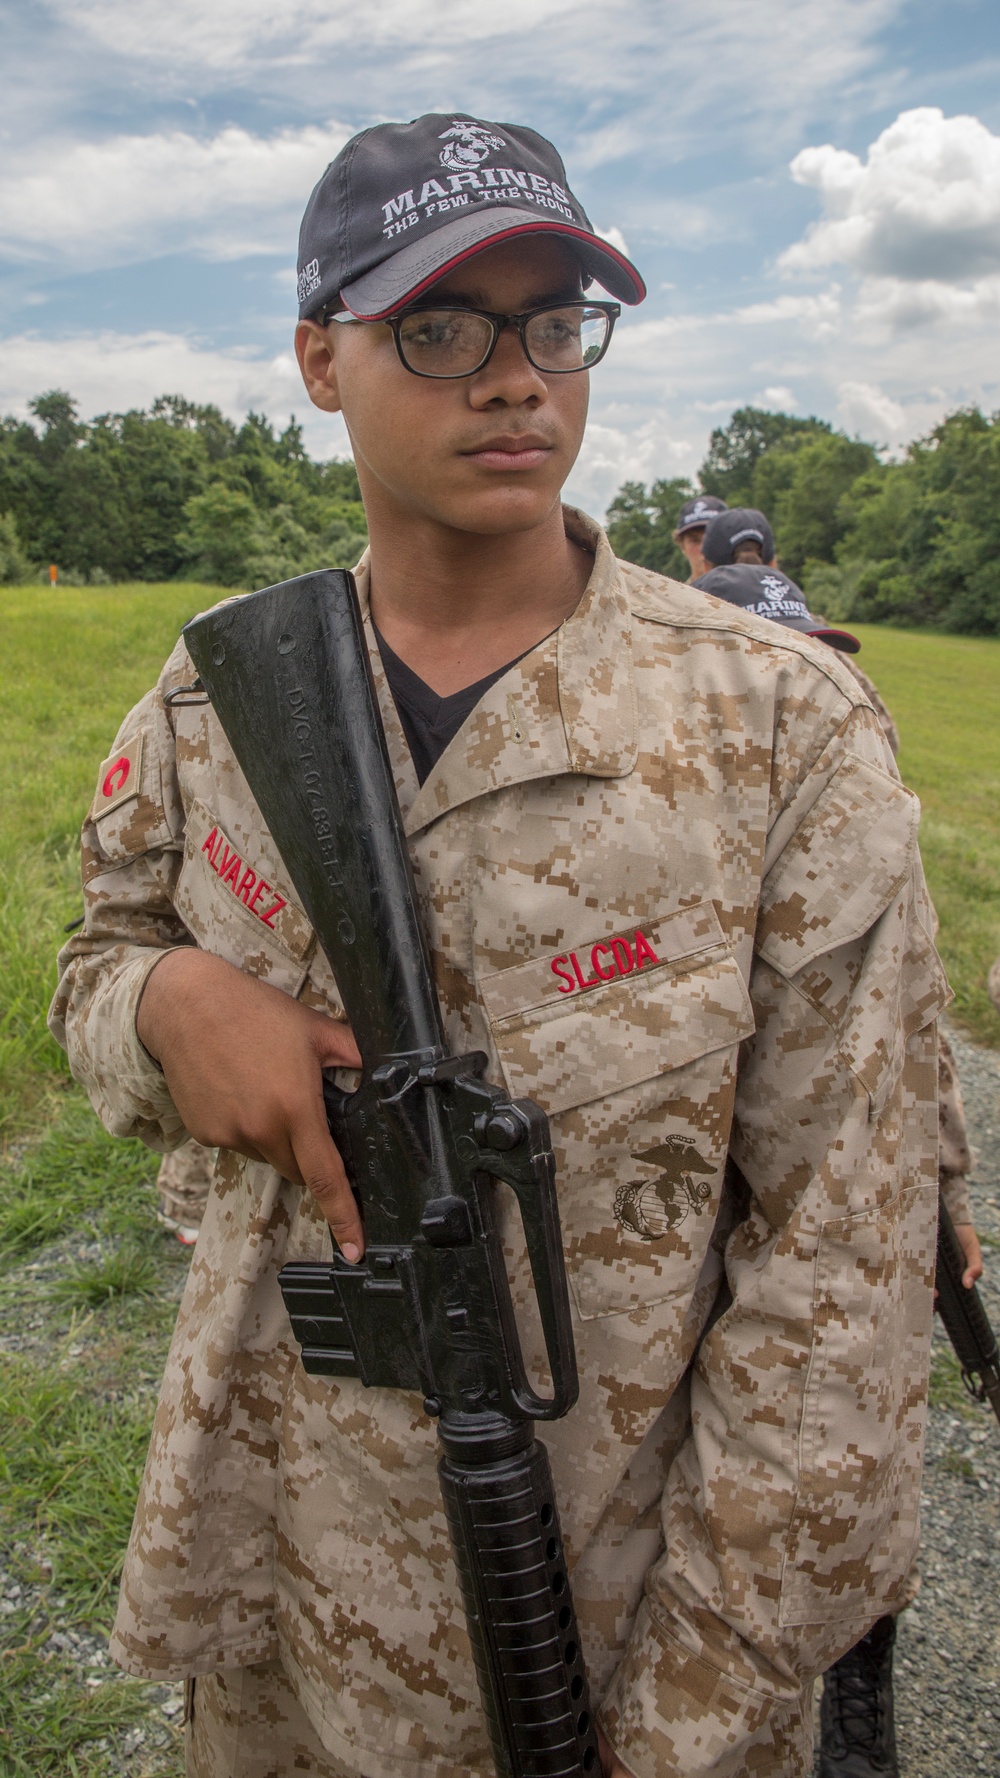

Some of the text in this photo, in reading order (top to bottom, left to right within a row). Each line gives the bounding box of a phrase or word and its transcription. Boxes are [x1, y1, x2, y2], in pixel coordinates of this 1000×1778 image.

[382, 168, 569, 225] MARINES
[383, 186, 576, 239] THE FEW. THE PROUD.
[202, 826, 288, 931] ALVAREZ
[550, 930, 660, 994] SLCDA
